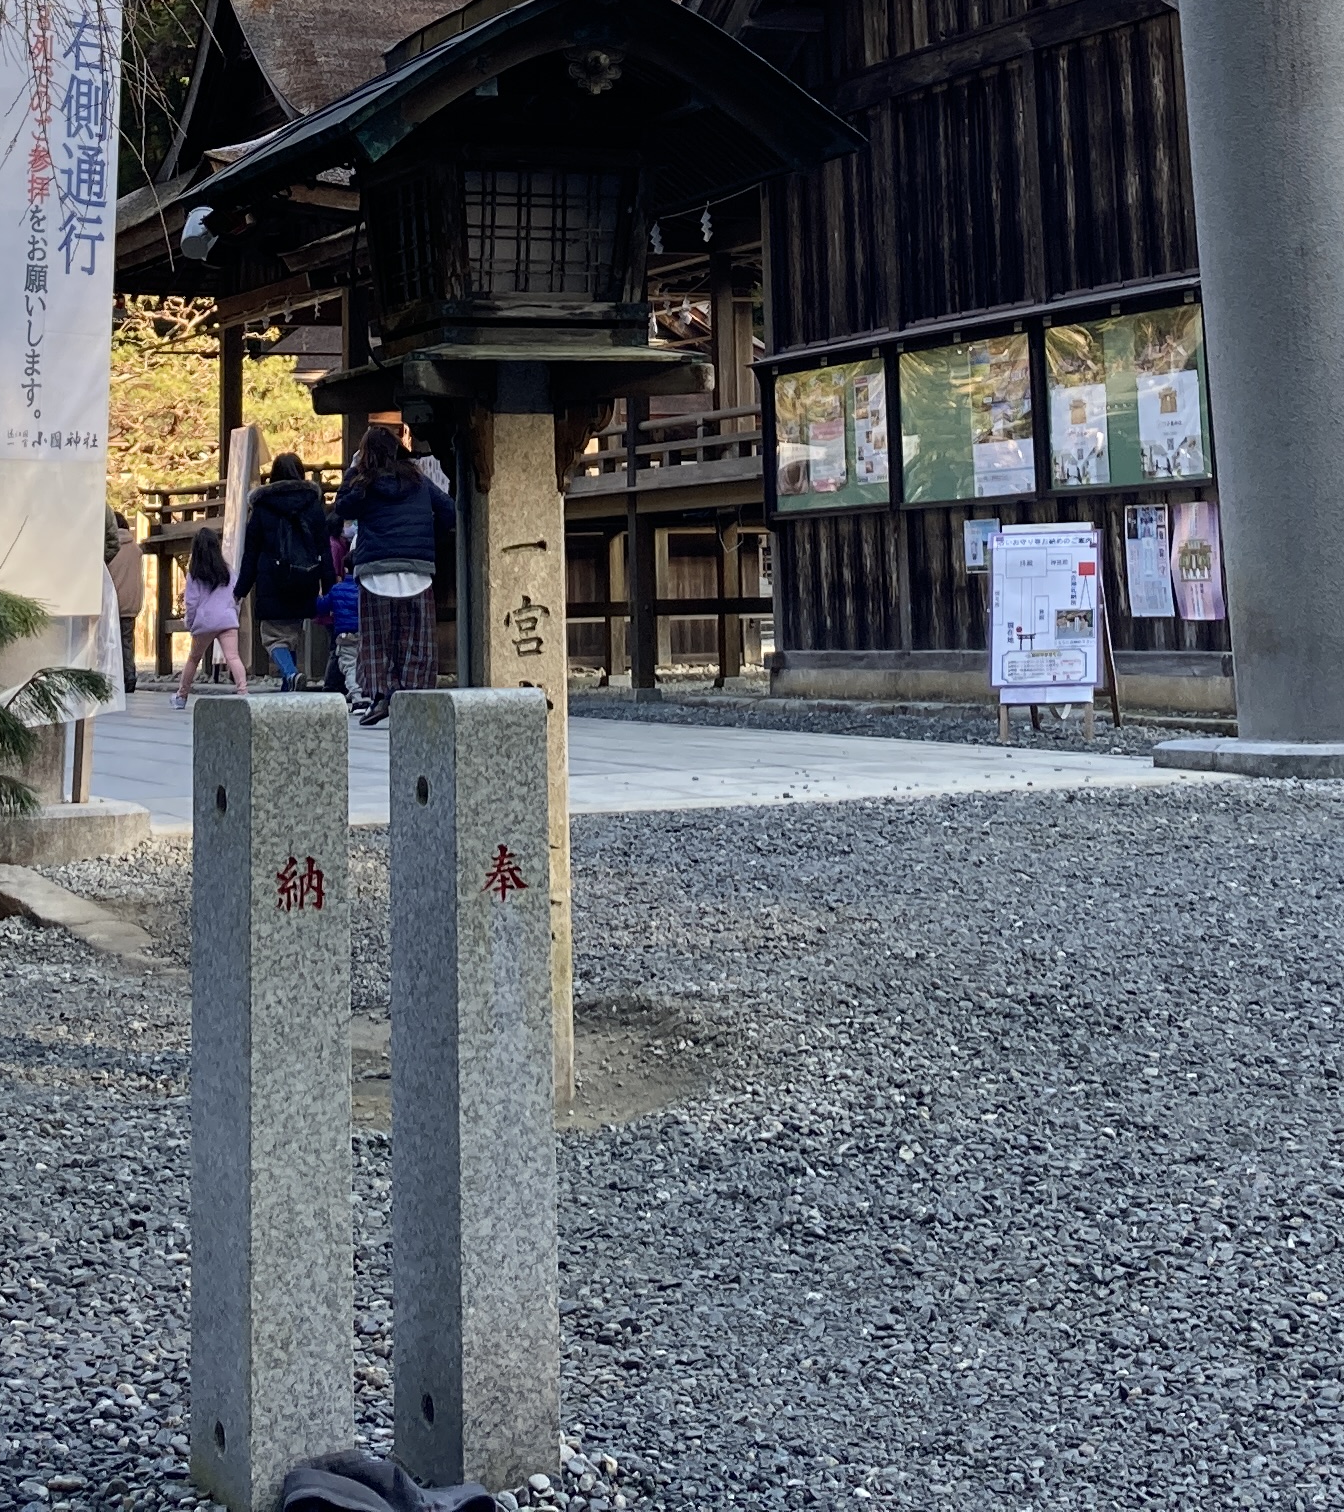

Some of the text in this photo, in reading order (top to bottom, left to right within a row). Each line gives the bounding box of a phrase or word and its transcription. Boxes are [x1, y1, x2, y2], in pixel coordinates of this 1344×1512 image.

[56, 10, 113, 276] 右側通行
[275, 856, 325, 911] 納
[480, 844, 529, 901] 奉
